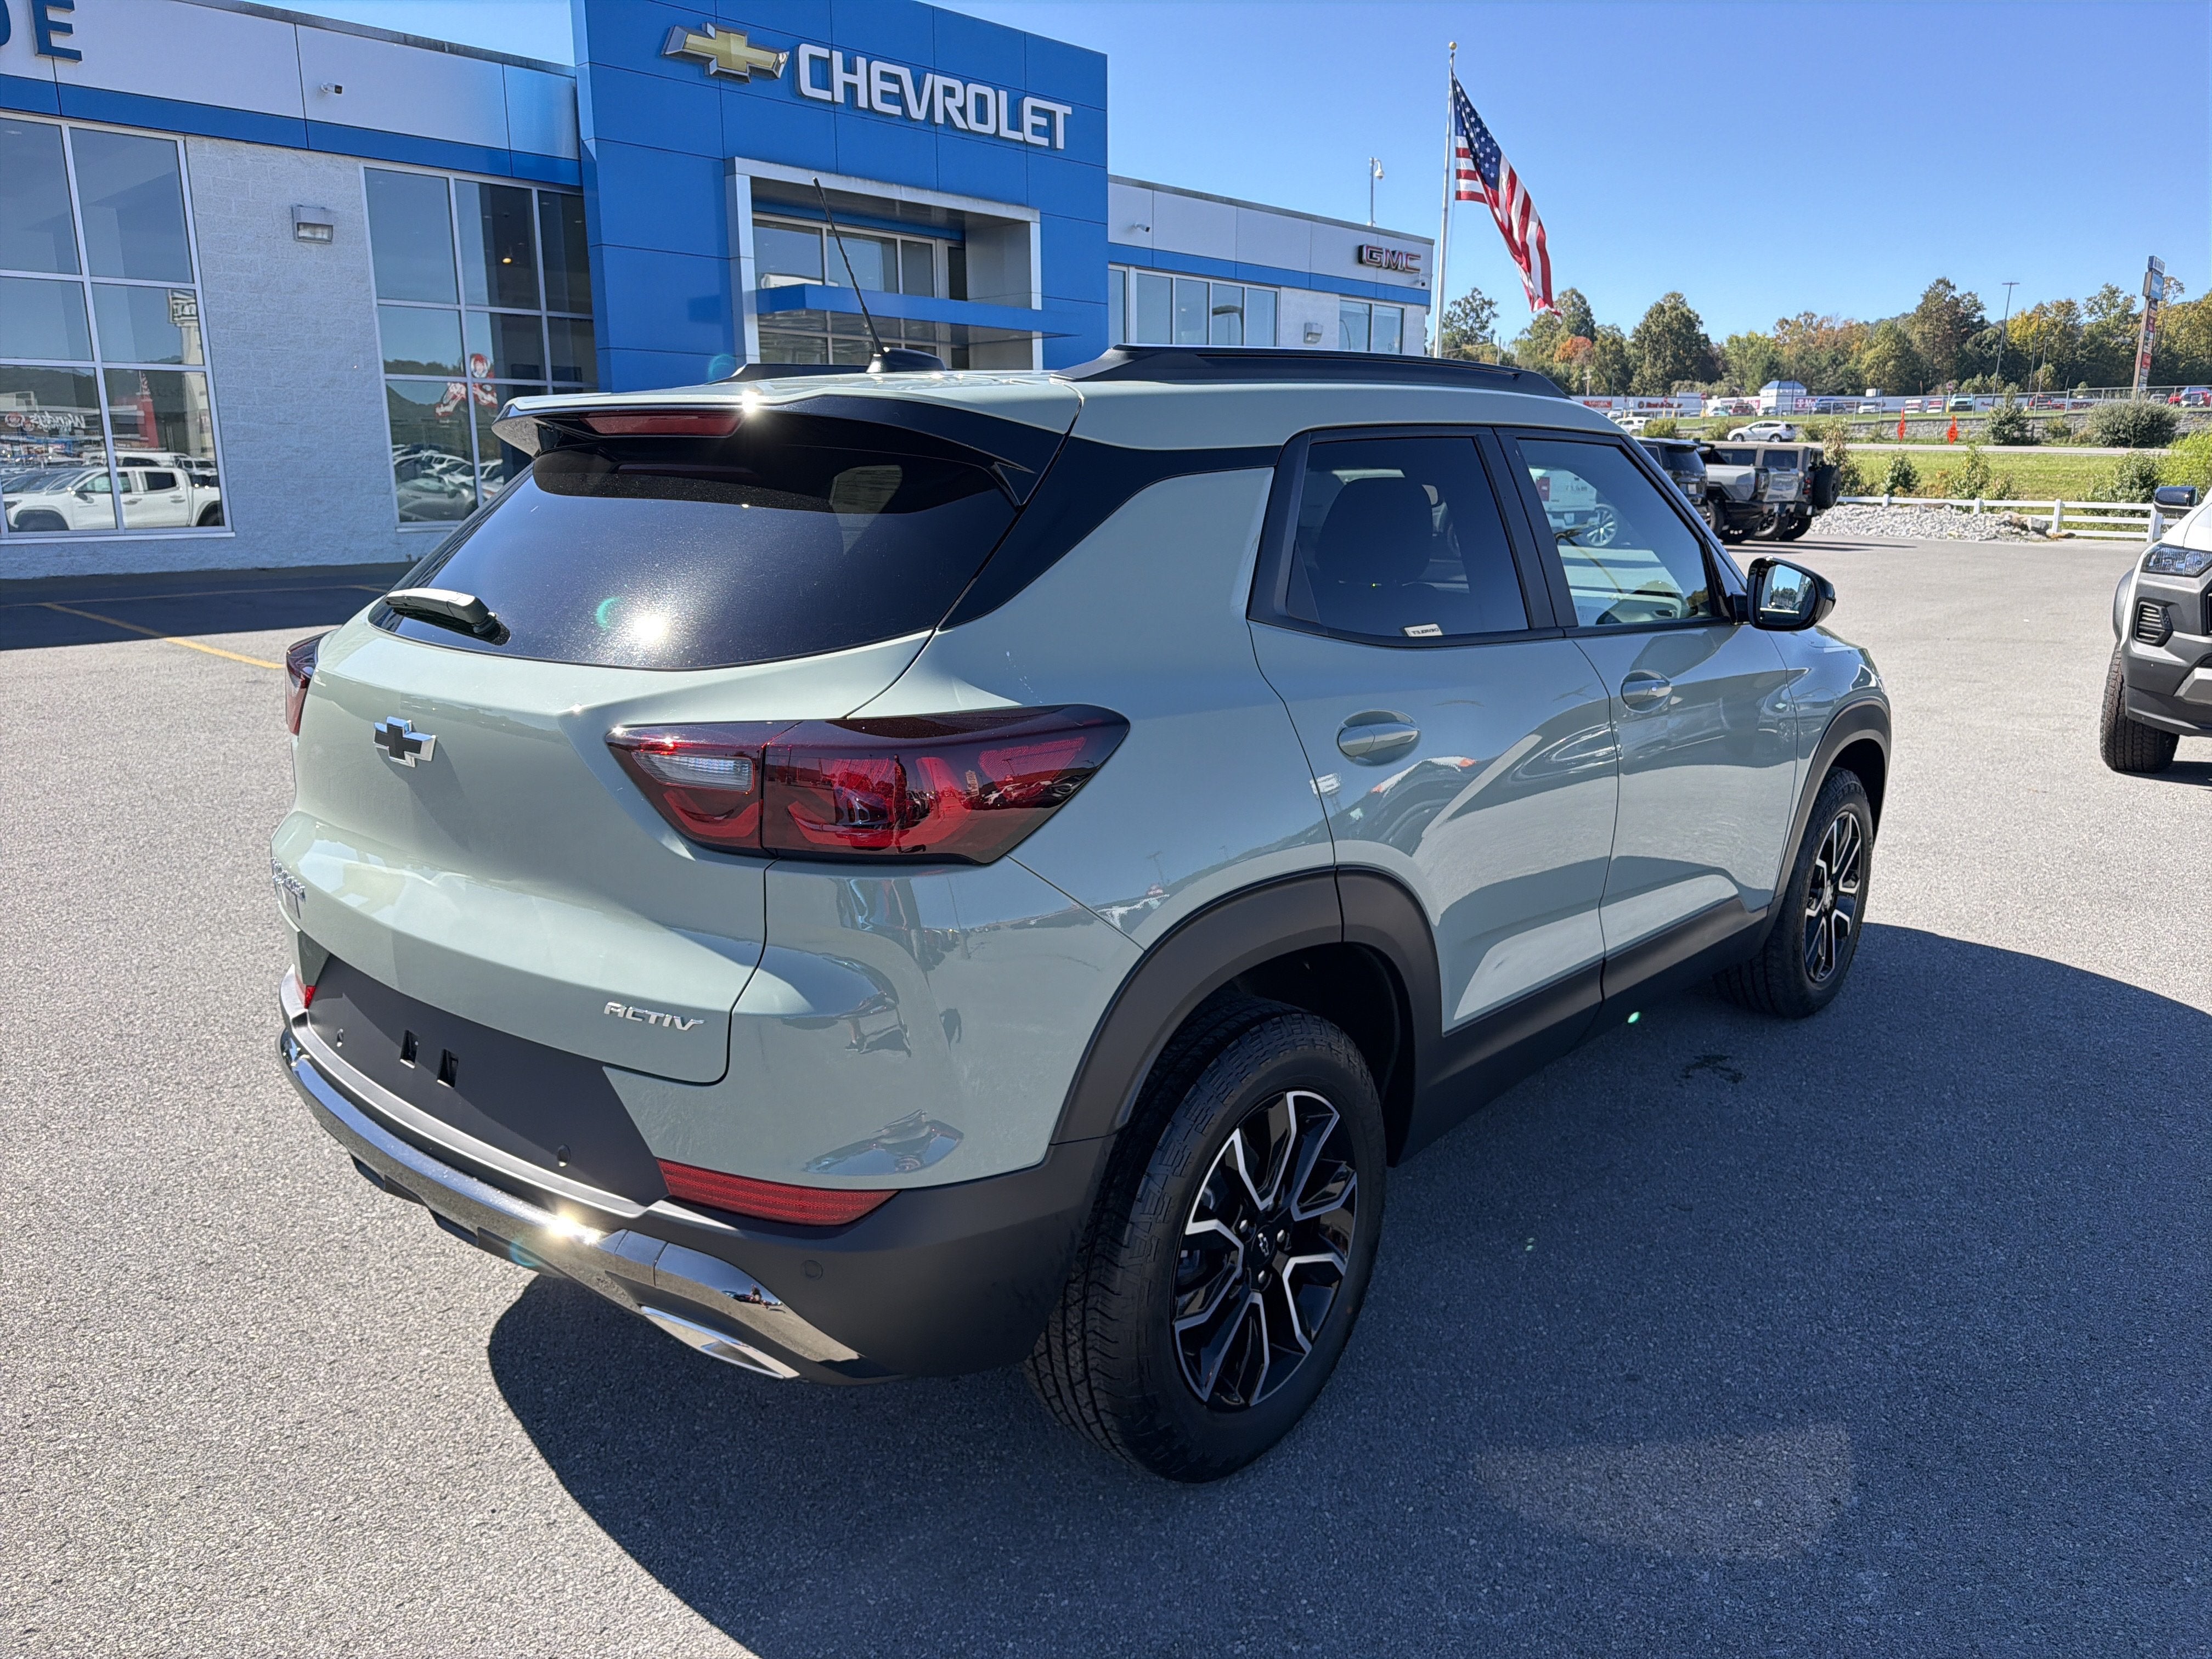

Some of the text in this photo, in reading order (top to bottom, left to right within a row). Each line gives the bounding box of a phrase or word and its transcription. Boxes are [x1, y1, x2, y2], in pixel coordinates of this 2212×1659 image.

[0, 0, 82, 62] E
[798, 43, 1073, 149] CHEVROLET
[1362, 245, 1421, 273] GMC
[603, 1002, 705, 1031] ACTIV
